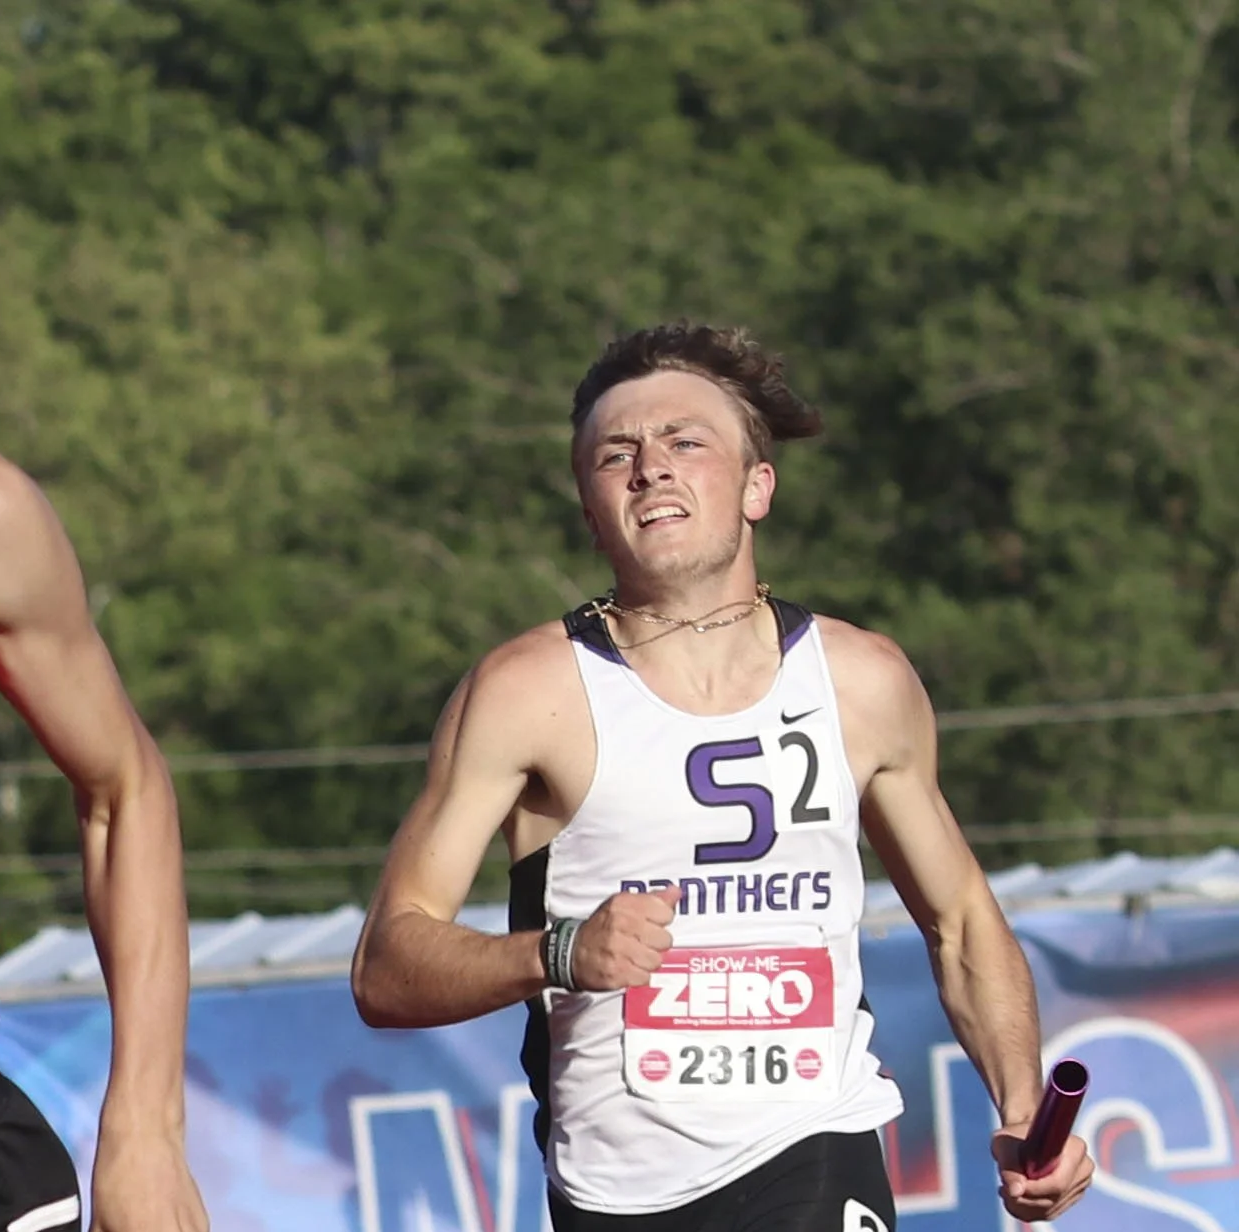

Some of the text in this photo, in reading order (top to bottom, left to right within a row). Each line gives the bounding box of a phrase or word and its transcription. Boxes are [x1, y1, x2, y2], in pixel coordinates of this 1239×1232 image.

[685, 736, 779, 865] S
[778, 731, 831, 824] 2
[689, 955, 780, 973] SHOW-ME
[648, 969, 814, 1018] ZERO
[679, 1045, 789, 1085] 2316
